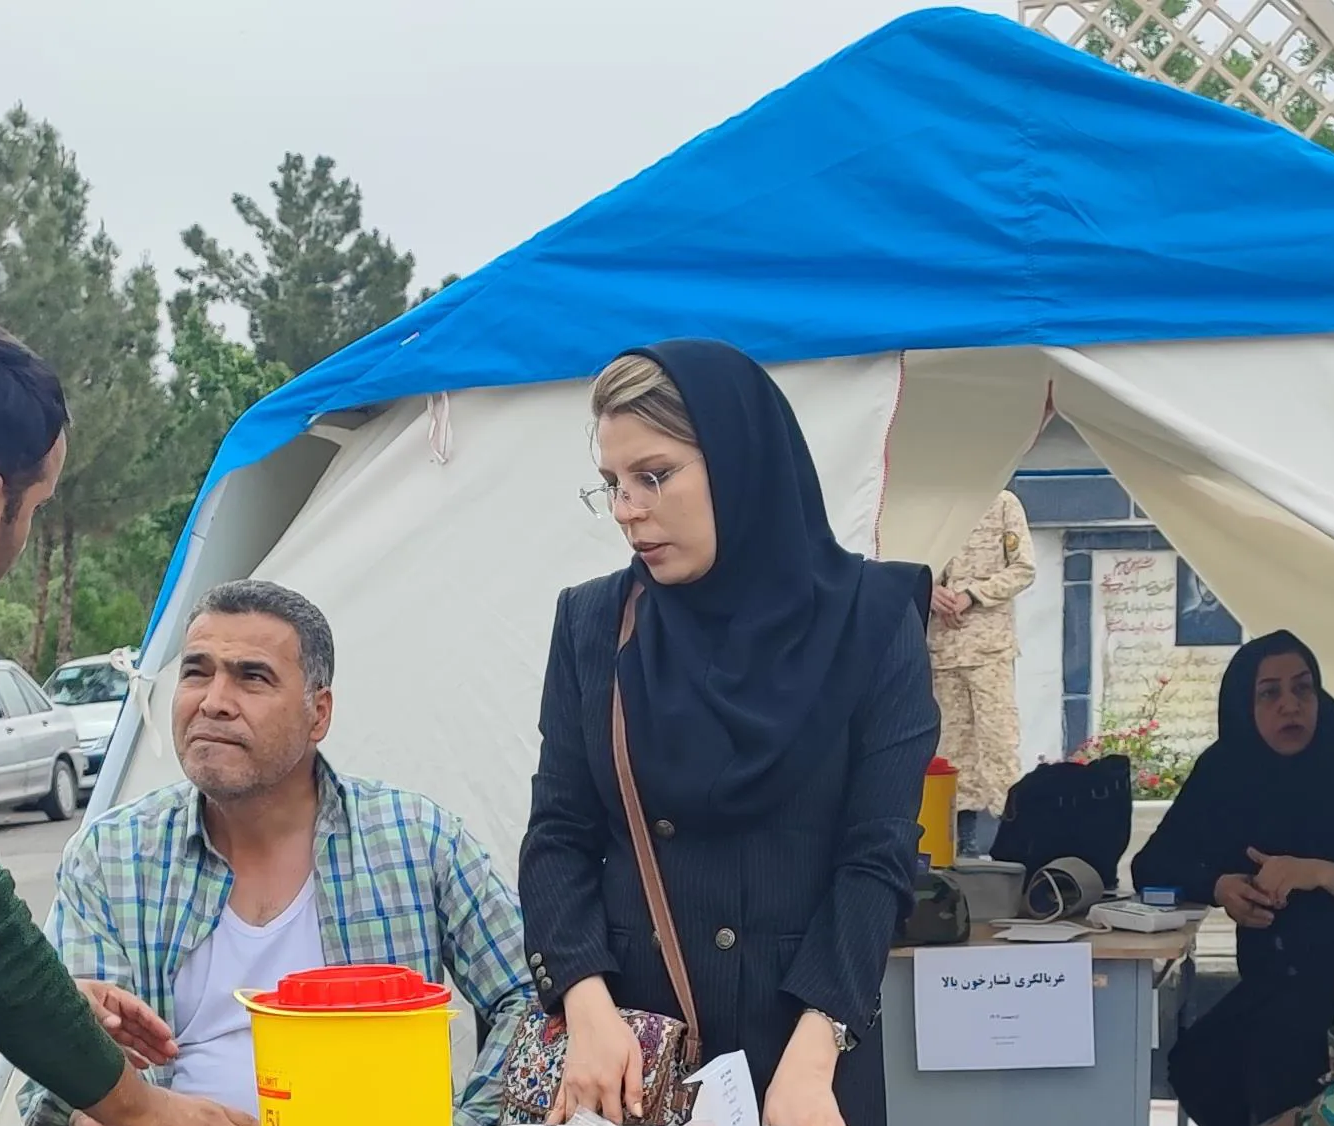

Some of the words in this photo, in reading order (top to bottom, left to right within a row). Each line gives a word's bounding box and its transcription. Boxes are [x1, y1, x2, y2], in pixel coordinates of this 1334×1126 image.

[941, 975, 958, 990] بالا
[961, 973, 985, 990] خون
[987, 971, 1011, 990] فشار
[1014, 971, 1066, 989] غربالگری
